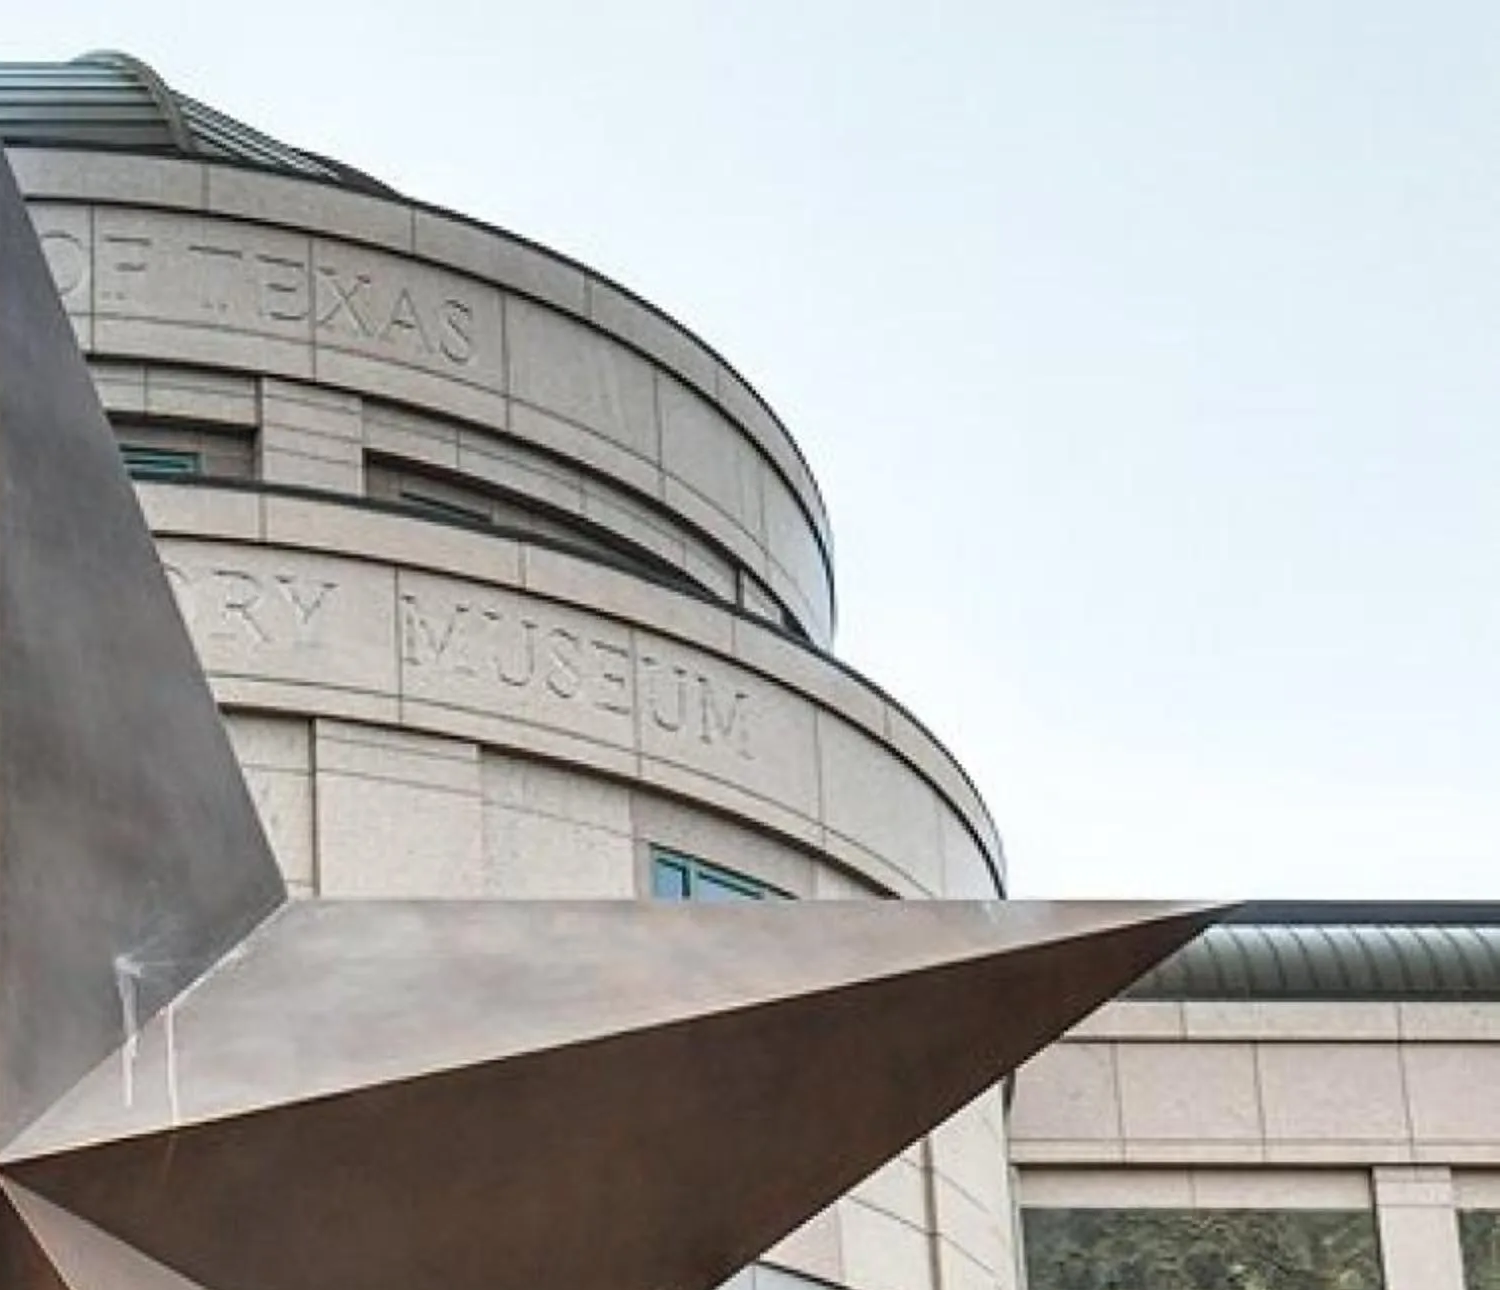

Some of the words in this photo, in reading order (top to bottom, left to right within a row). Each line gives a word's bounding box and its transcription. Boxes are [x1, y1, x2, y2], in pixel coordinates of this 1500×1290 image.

[40, 229, 152, 300] OF
[187, 244, 474, 364] TEXAS
[401, 595, 755, 760] MUSEUM
